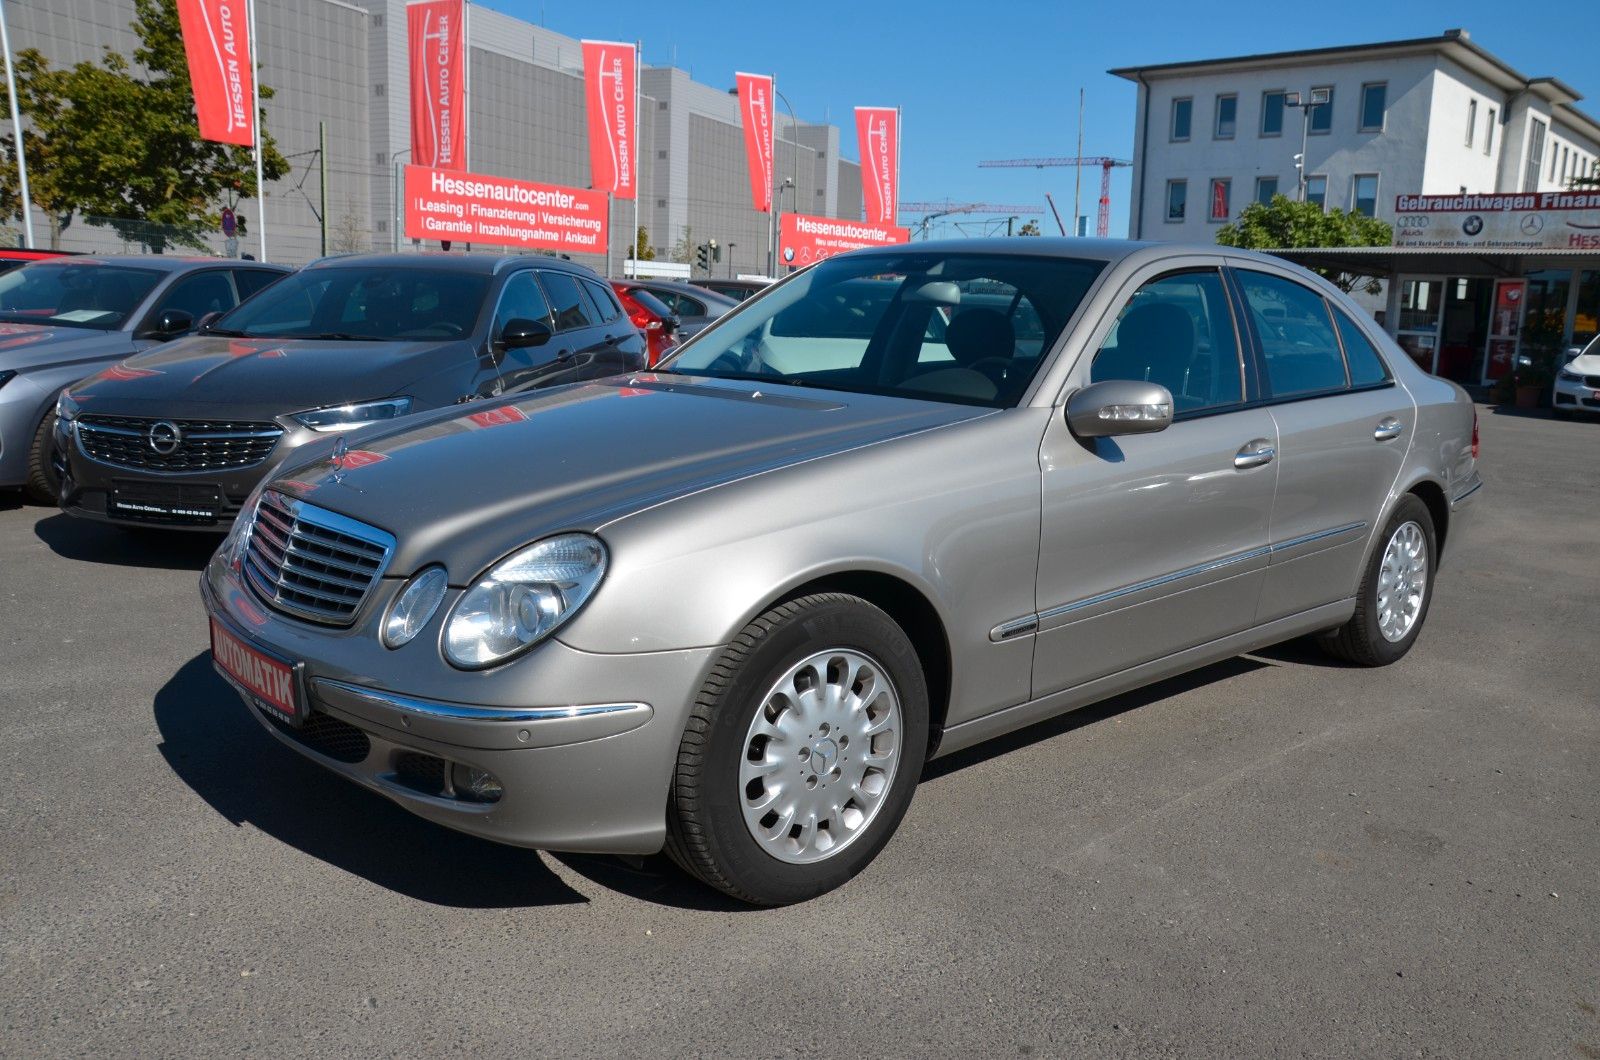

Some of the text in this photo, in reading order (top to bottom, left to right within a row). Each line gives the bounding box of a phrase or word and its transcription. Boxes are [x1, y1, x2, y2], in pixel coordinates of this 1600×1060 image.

[220, 5, 247, 128] HESSEN AUTO
[439, 68, 450, 106] AUTO
[439, 109, 451, 163] HESSEN
[616, 105, 626, 138] AUTO
[763, 129, 771, 159] AUTO
[619, 140, 630, 187] HESSEN
[881, 156, 890, 181] AUTO
[420, 198, 602, 232] Leasing Finanzierung Versicherung
[883, 182, 892, 219] HESSEN
[1399, 193, 1600, 212] Gebrauchtwagen Finan
[426, 217, 596, 245] Garantie Inzahlungnahme Ankauf
[815, 237, 827, 246] Neu
[827, 239, 838, 247] und
[213, 624, 295, 710] AUTOMATIK
